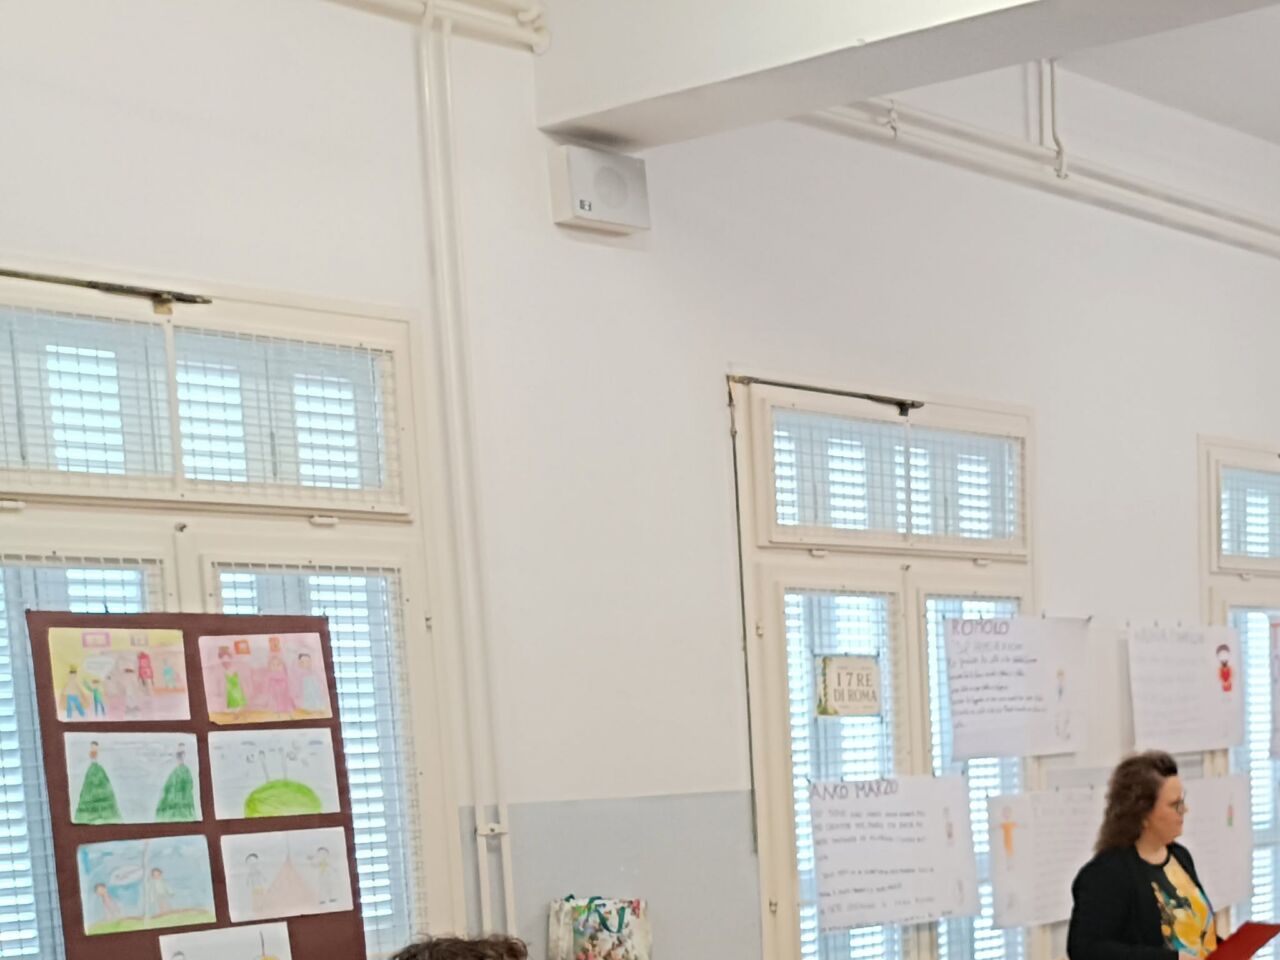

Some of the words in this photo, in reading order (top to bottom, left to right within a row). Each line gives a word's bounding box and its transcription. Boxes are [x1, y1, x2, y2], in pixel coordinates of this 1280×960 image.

[951, 618, 1010, 637] ROMOLO
[845, 671, 854, 688] 7
[856, 671, 873, 688] RE
[833, 687, 845, 703] DI
[847, 687, 879, 703] ROMA
